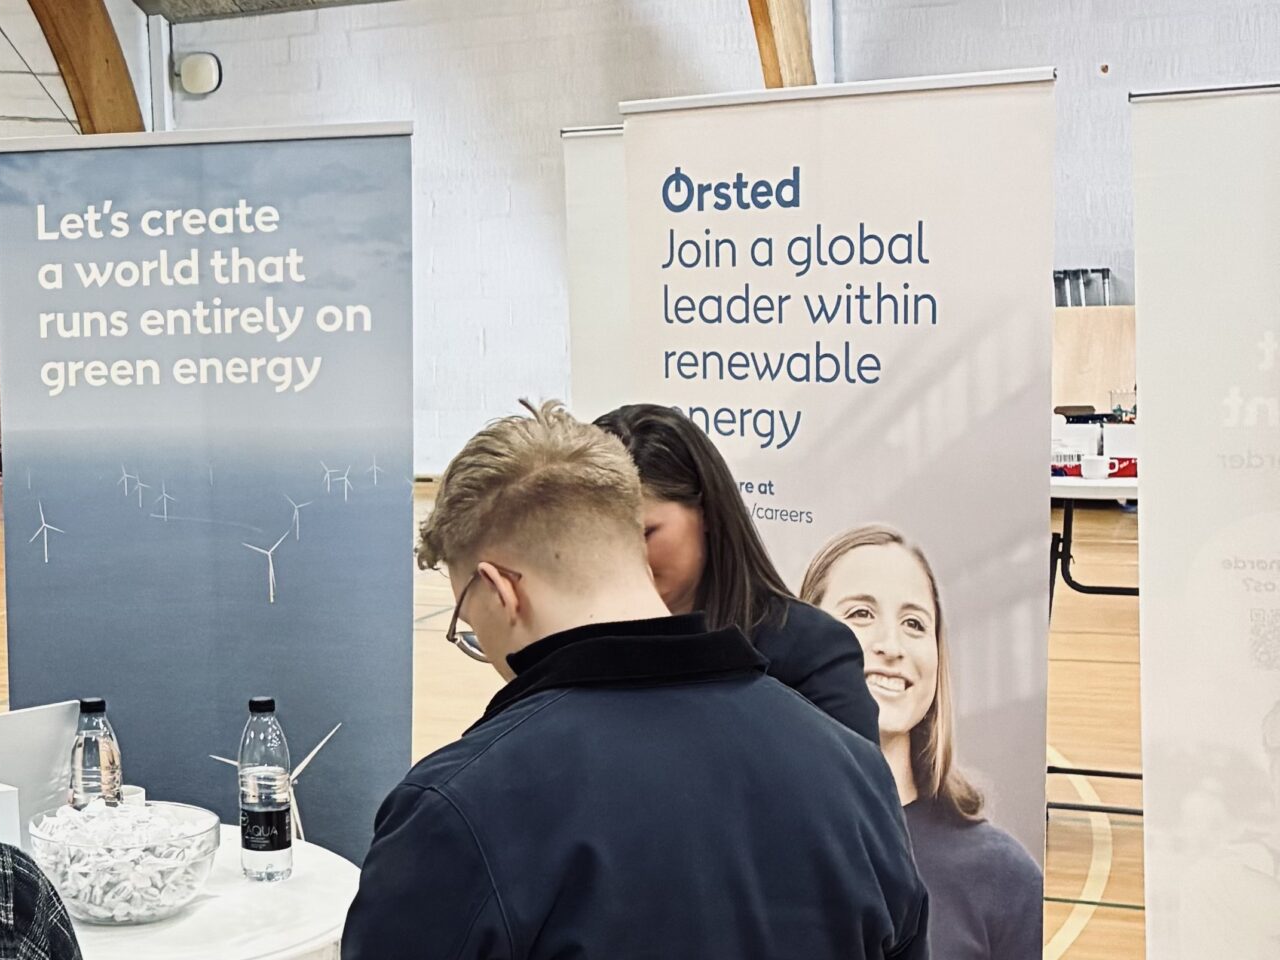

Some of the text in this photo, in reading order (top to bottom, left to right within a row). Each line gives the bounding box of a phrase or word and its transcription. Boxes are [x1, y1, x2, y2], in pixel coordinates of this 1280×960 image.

[36, 199, 280, 241] Let's create
[37, 247, 306, 290] a world that
[662, 220, 930, 277] Join a global
[39, 296, 372, 342] runs entirely on
[664, 281, 938, 325] leader within
[40, 356, 322, 397] green energy
[664, 340, 881, 384] renewable
[688, 404, 802, 450] nergy
[758, 480, 775, 496] at
[751, 503, 813, 524] /careers
